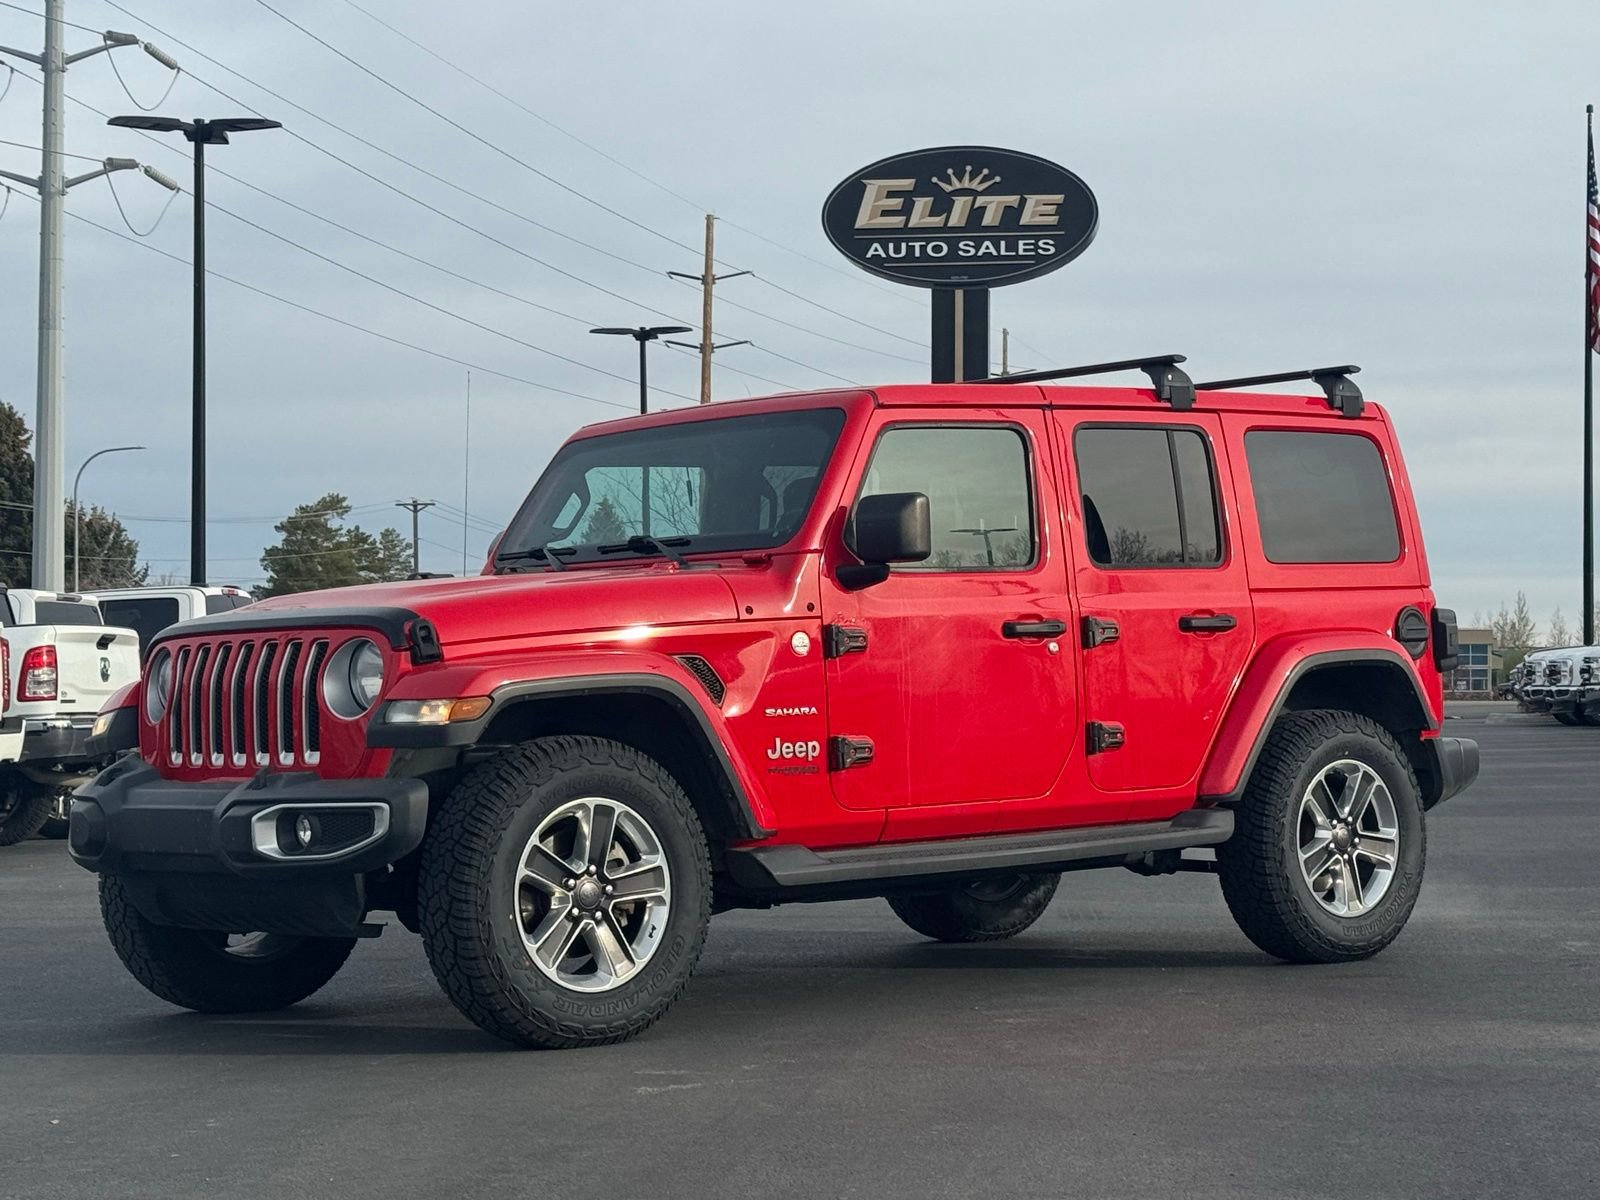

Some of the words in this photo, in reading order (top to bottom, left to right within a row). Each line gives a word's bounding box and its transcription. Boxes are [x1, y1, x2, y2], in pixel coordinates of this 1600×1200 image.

[854, 178, 1065, 229] ELITE
[866, 241, 948, 258] AUTO
[957, 239, 1056, 256] SALES
[765, 706, 818, 717] SAHARA
[767, 737, 820, 761] Jeep
[552, 934, 686, 1018] GEOLANDAR
